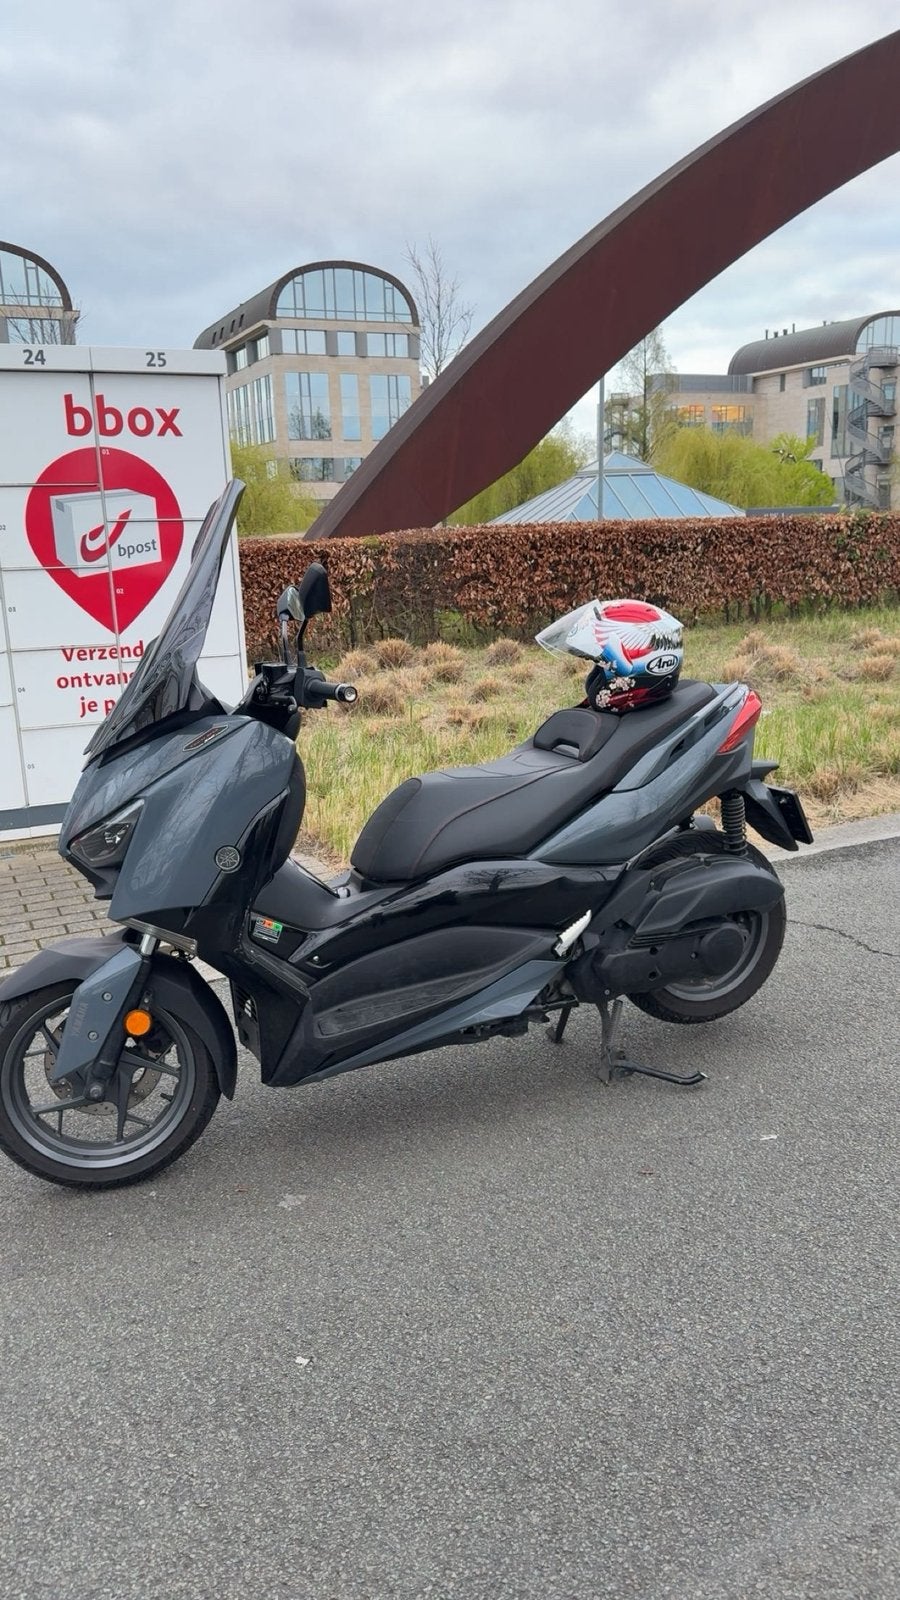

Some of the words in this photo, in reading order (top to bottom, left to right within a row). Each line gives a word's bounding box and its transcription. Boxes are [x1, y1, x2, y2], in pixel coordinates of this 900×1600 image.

[23, 349, 46, 365] 24
[145, 352, 167, 367] 25
[64, 394, 183, 437] bbox
[118, 538, 158, 558] bpost
[60, 640, 144, 662] Verzend
[649, 656, 675, 670] Arai
[80, 696, 98, 718] je
